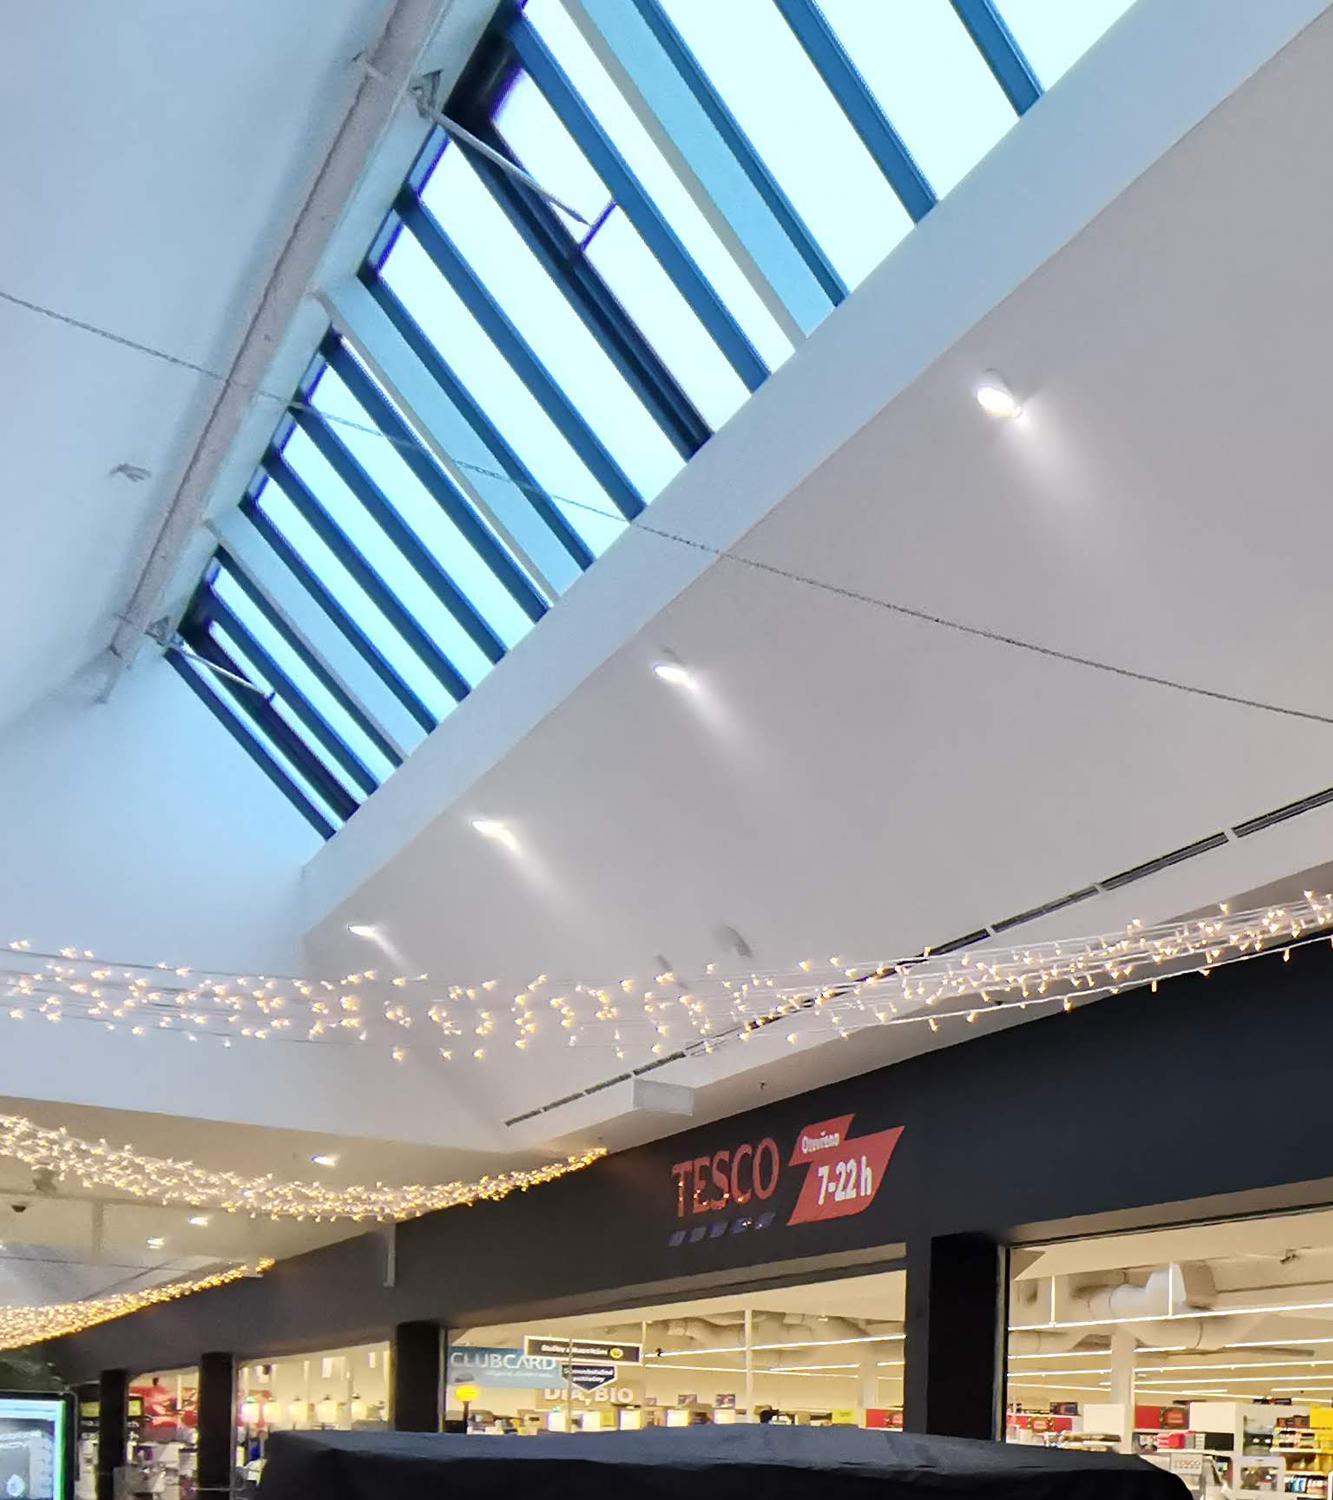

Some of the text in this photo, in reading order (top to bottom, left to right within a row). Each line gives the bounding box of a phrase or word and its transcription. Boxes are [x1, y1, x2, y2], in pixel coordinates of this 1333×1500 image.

[672, 1137, 780, 1217] TESCO
[818, 1159, 857, 1206] 7-22
[451, 1352, 556, 1370] CLUBCARD
[595, 1387, 633, 1403] BIO
